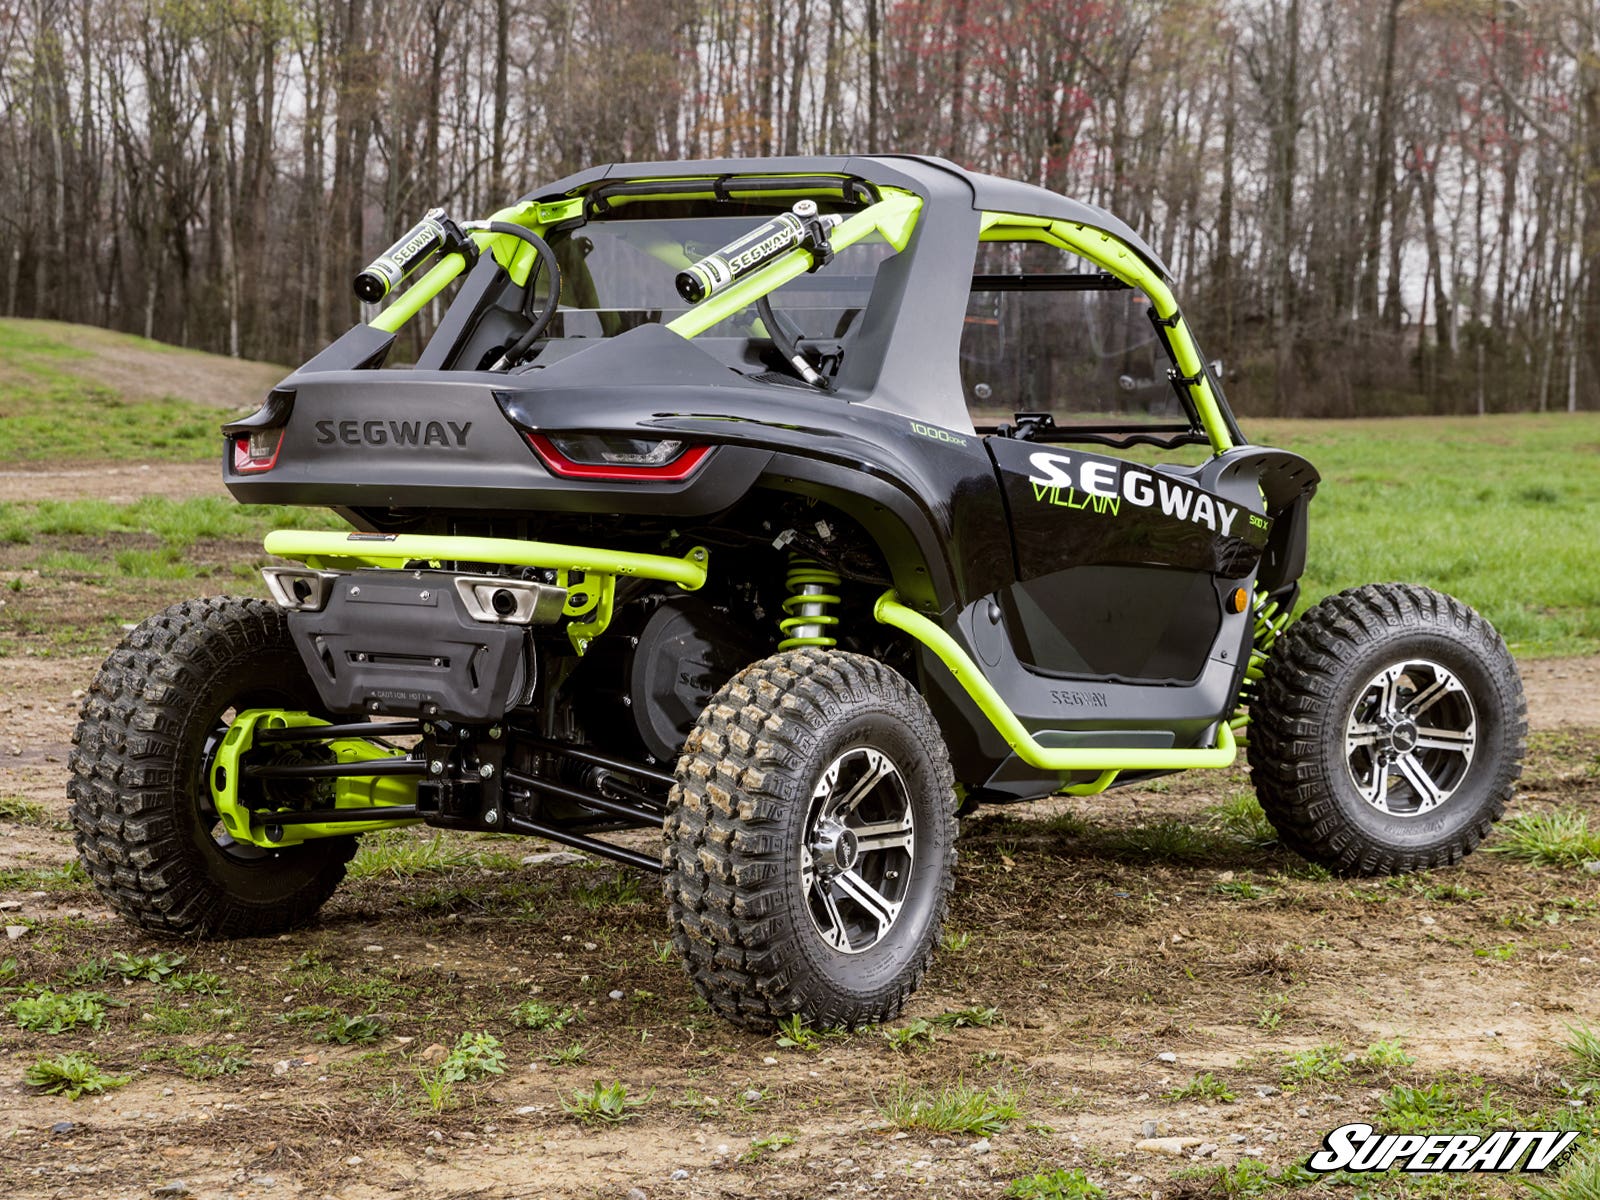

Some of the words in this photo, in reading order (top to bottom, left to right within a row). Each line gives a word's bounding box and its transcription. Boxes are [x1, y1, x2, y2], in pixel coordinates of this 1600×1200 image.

[391, 226, 437, 266] SEGWAY
[728, 229, 792, 275] SEGWAY
[315, 420, 473, 448] SEGWAY
[910, 421, 949, 442] 1000
[1028, 451, 1239, 537] SEGWAY
[1032, 480, 1121, 517] VILLAIN
[1050, 690, 1108, 708] SEGWAY
